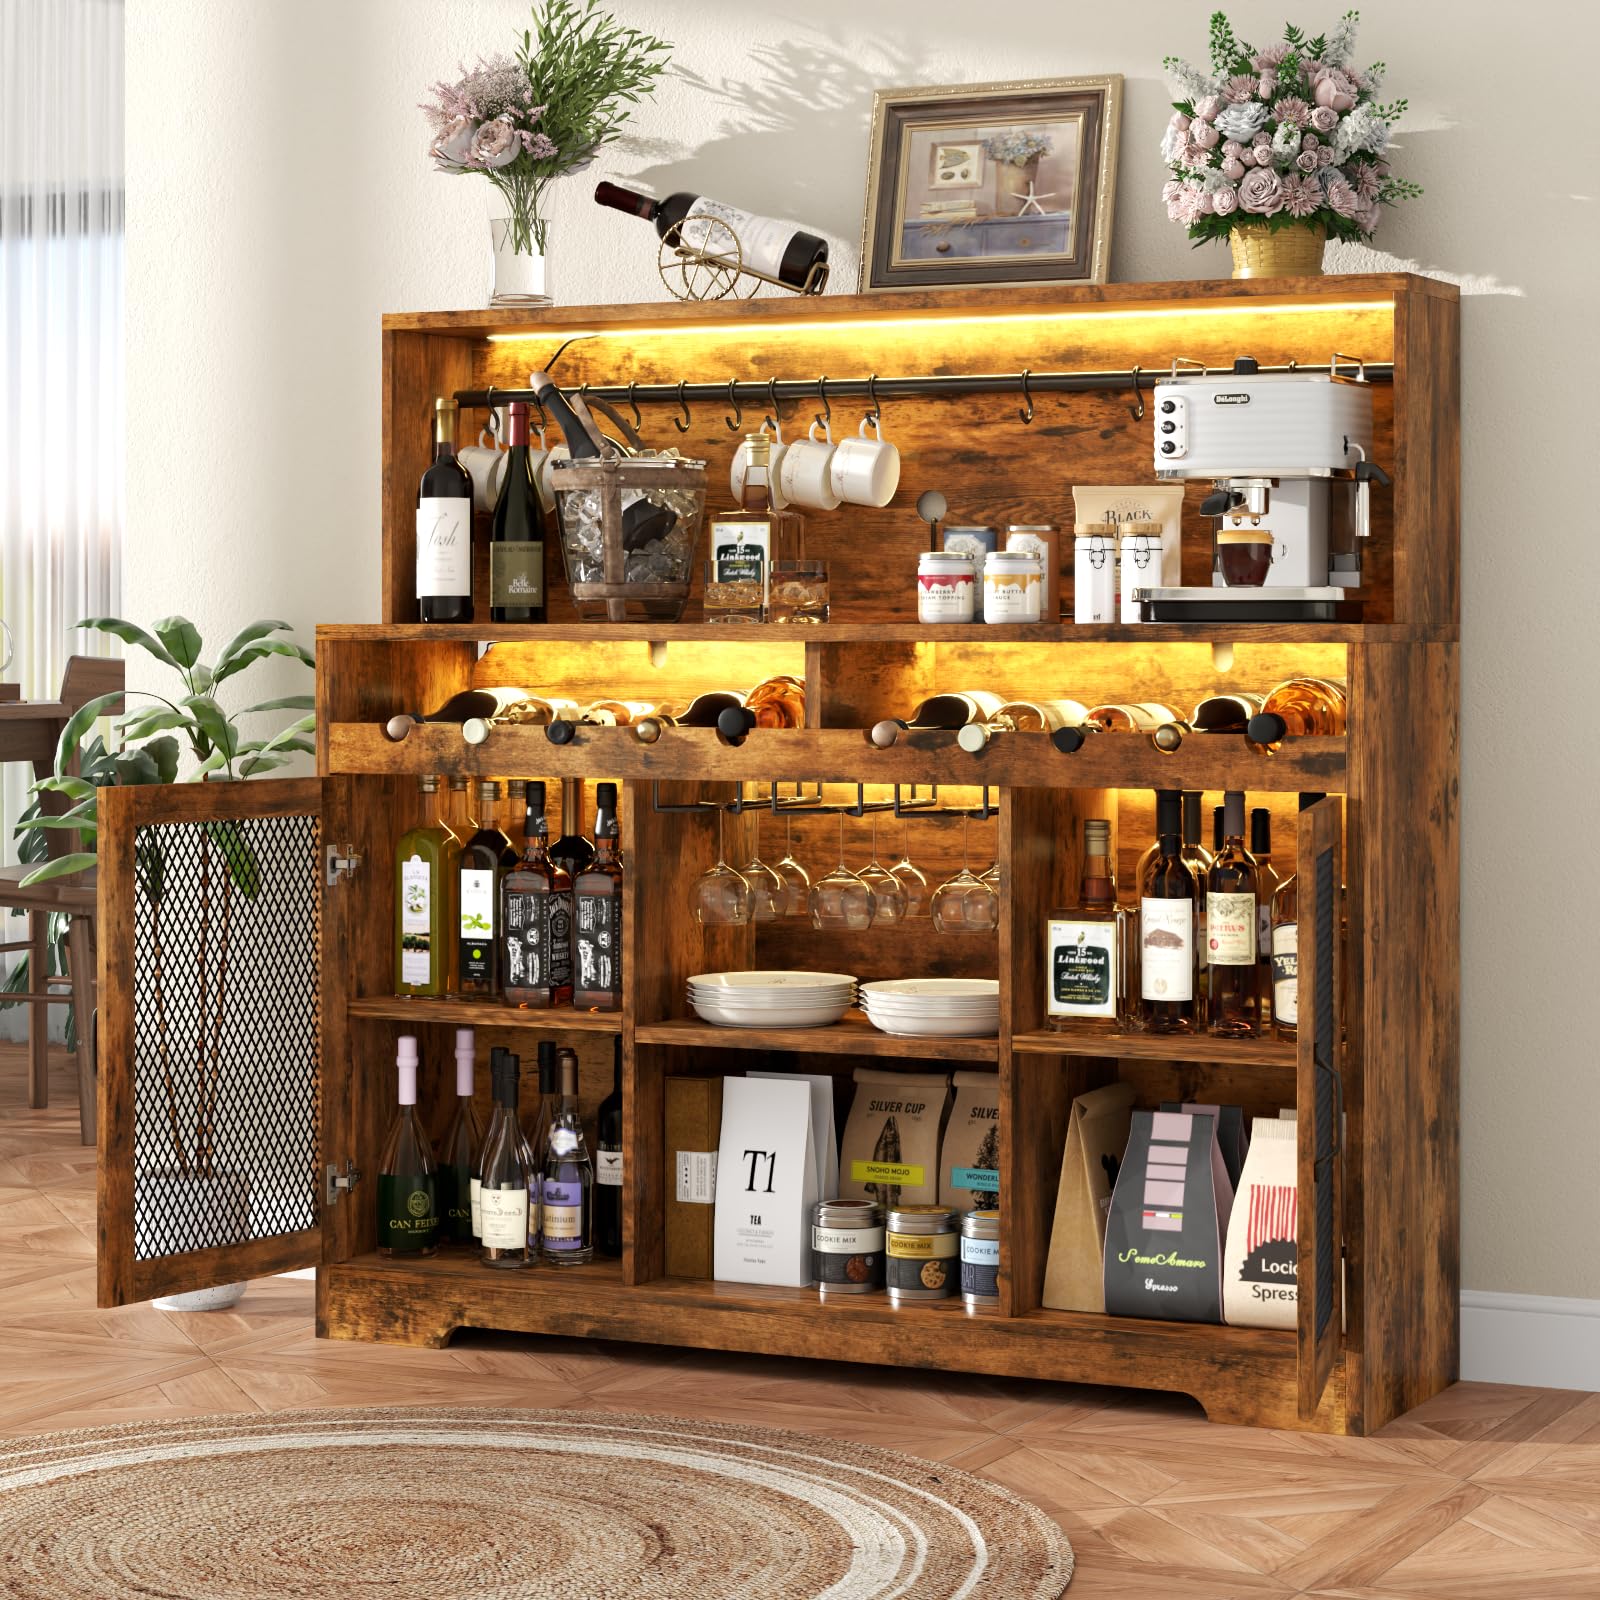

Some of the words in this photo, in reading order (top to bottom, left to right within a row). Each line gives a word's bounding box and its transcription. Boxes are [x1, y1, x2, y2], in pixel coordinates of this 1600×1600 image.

[1104, 509, 1152, 524] BLACK
[736, 545, 745, 554] 15
[720, 553, 760, 561] Linkwood
[1077, 947, 1087, 957] 15
[1057, 954, 1105, 965] Linkwood
[869, 1100, 902, 1113] SILVER
[904, 1102, 926, 1114] CUP
[970, 1106, 999, 1120] SILVE
[742, 1149, 776, 1194] T1
[866, 1166, 890, 1175] SNOHO
[891, 1167, 910, 1176] MOJO
[448, 1209, 469, 1217] CAN
[389, 1219, 411, 1229] CAN
[750, 1214, 762, 1226] TEA
[817, 1235, 840, 1244] COOKIE
[842, 1236, 857, 1244] MIX
[890, 1240, 916, 1249] COOKIE
[967, 1246, 991, 1255] COOKIE
[1144, 1278, 1179, 1292] Spresso
